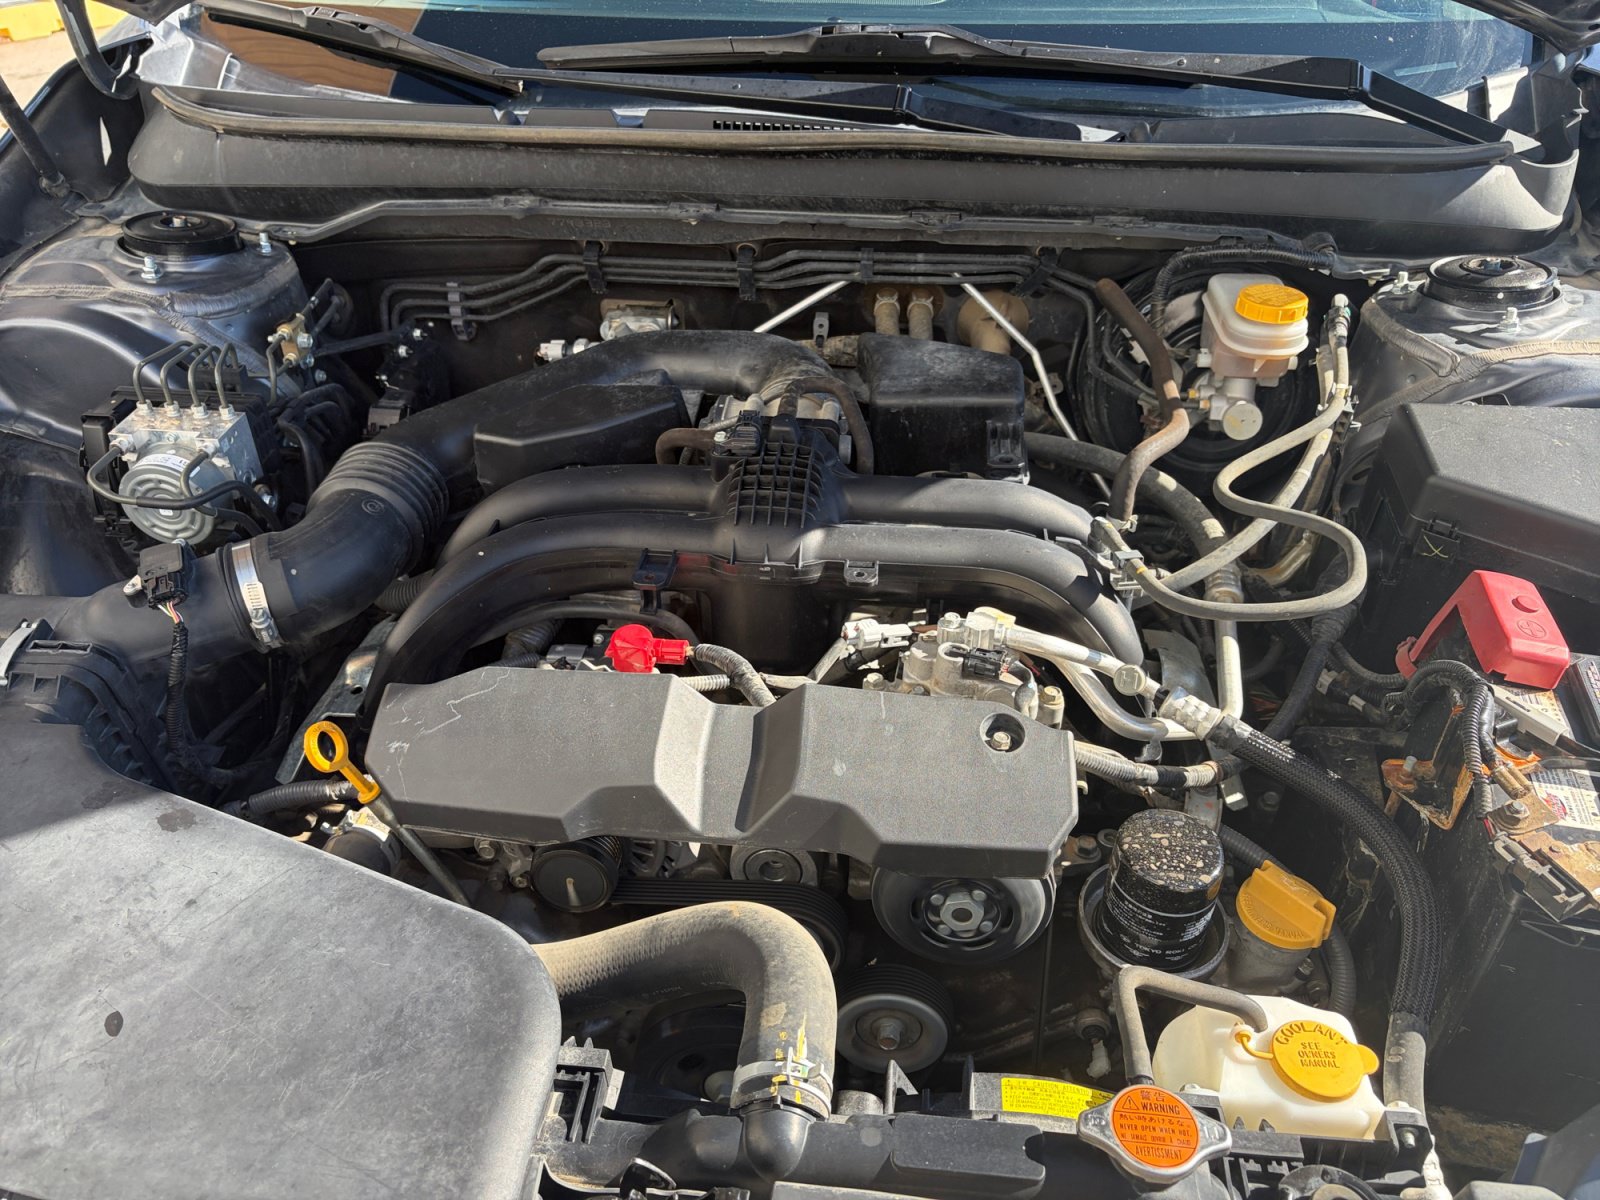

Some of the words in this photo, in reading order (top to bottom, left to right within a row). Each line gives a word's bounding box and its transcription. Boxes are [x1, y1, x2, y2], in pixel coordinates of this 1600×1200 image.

[1275, 1022, 1348, 1046] COOLANT
[1300, 1042, 1321, 1050] SEE
[1298, 1050, 1337, 1060] OWNERS
[1300, 1059, 1341, 1069] MANUAL
[1142, 1102, 1180, 1115] WARNING
[1120, 1123, 1138, 1131] NEVER
